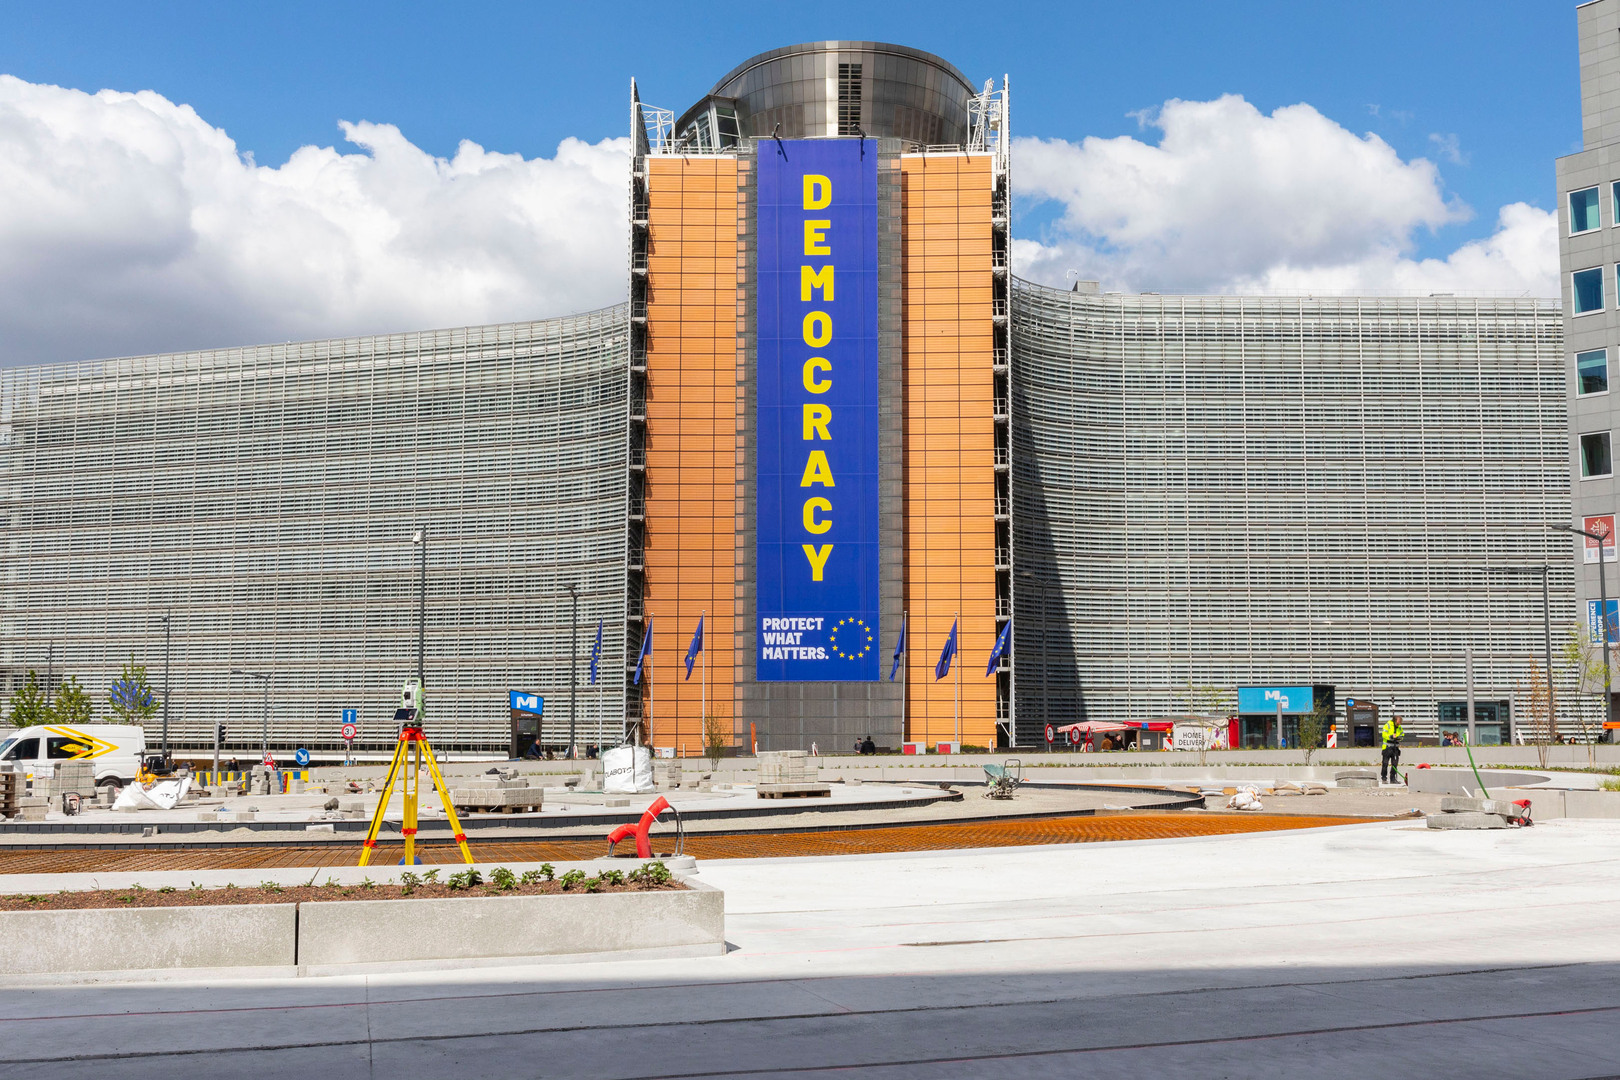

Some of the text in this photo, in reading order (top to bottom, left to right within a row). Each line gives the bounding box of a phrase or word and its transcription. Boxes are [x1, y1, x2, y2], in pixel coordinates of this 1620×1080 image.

[800, 174, 835, 581] DEMOCRACY
[763, 618, 824, 630] PROTECT
[1590, 602, 1598, 642] EXPERIENCE
[763, 633, 803, 645] WHAT
[763, 647, 829, 660] MATTERS.
